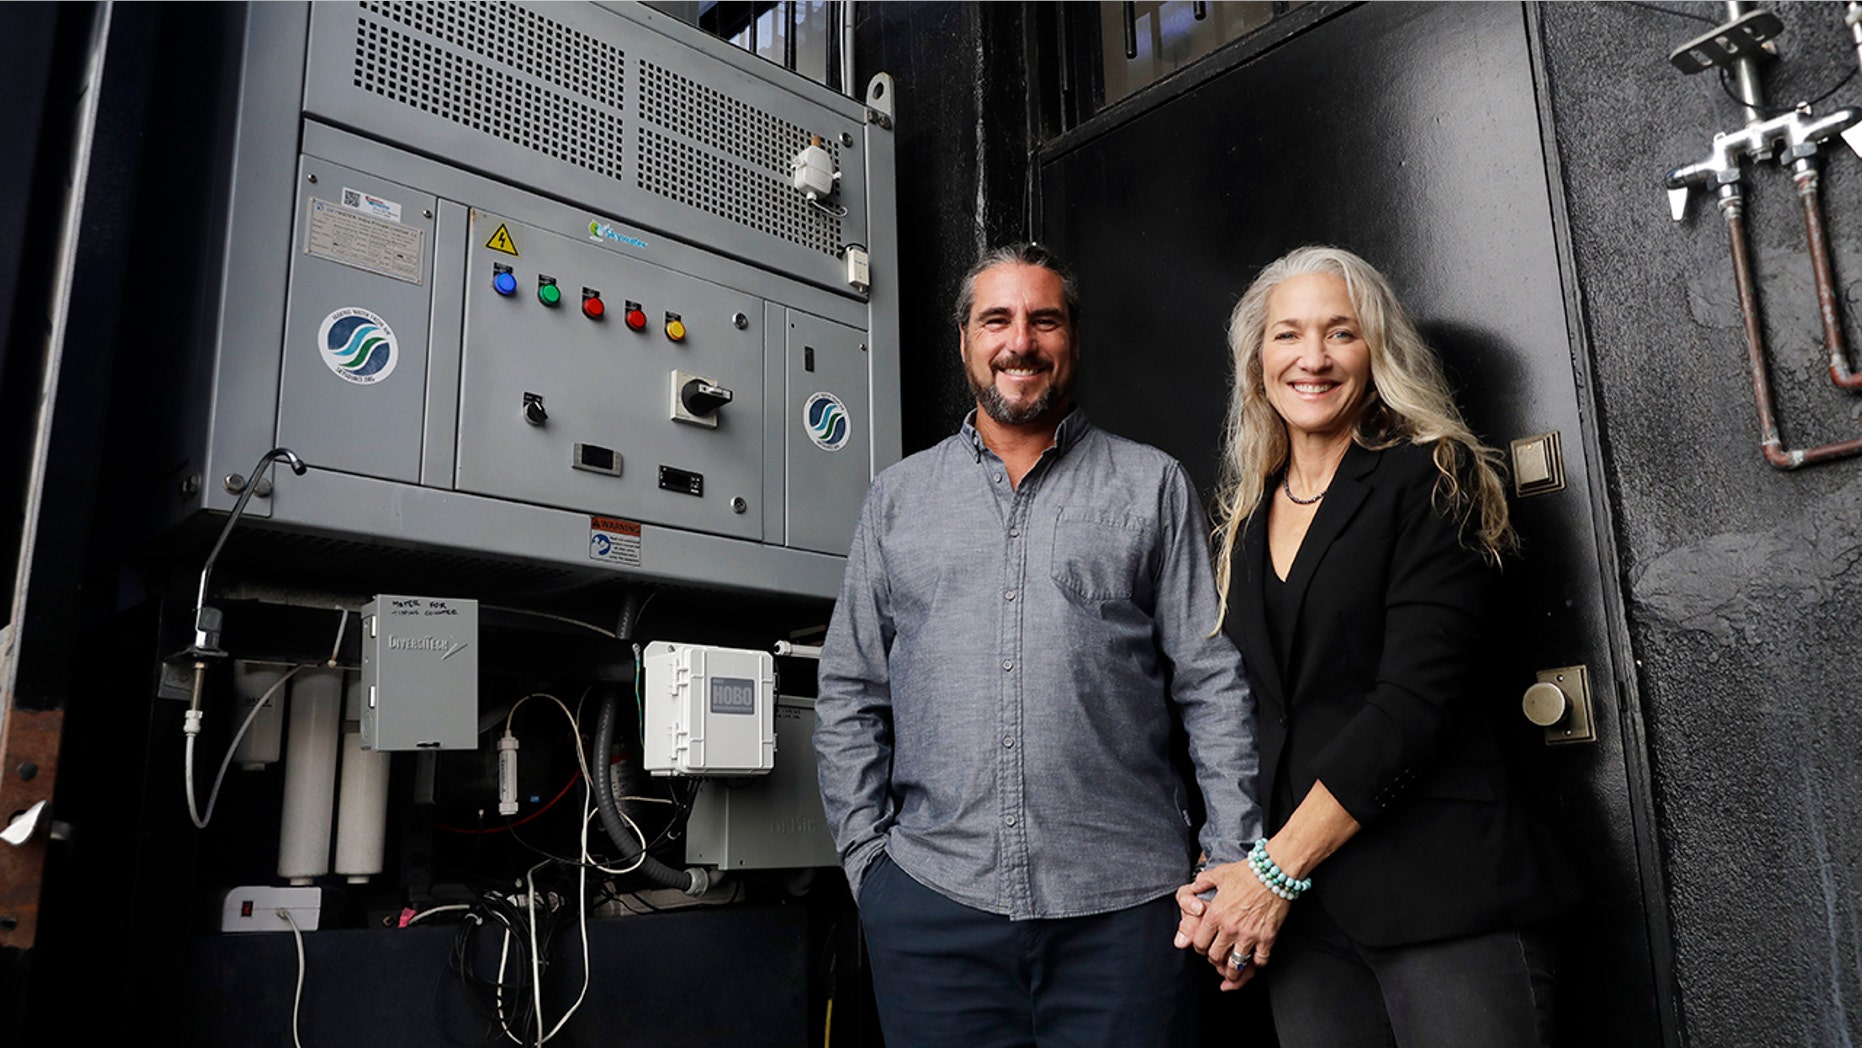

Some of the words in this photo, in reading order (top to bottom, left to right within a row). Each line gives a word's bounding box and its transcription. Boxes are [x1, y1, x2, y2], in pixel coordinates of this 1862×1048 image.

[605, 227, 647, 248] Skywater
[601, 519, 641, 534] WARNING
[429, 601, 447, 609] FOR
[713, 685, 752, 706] HOBO
